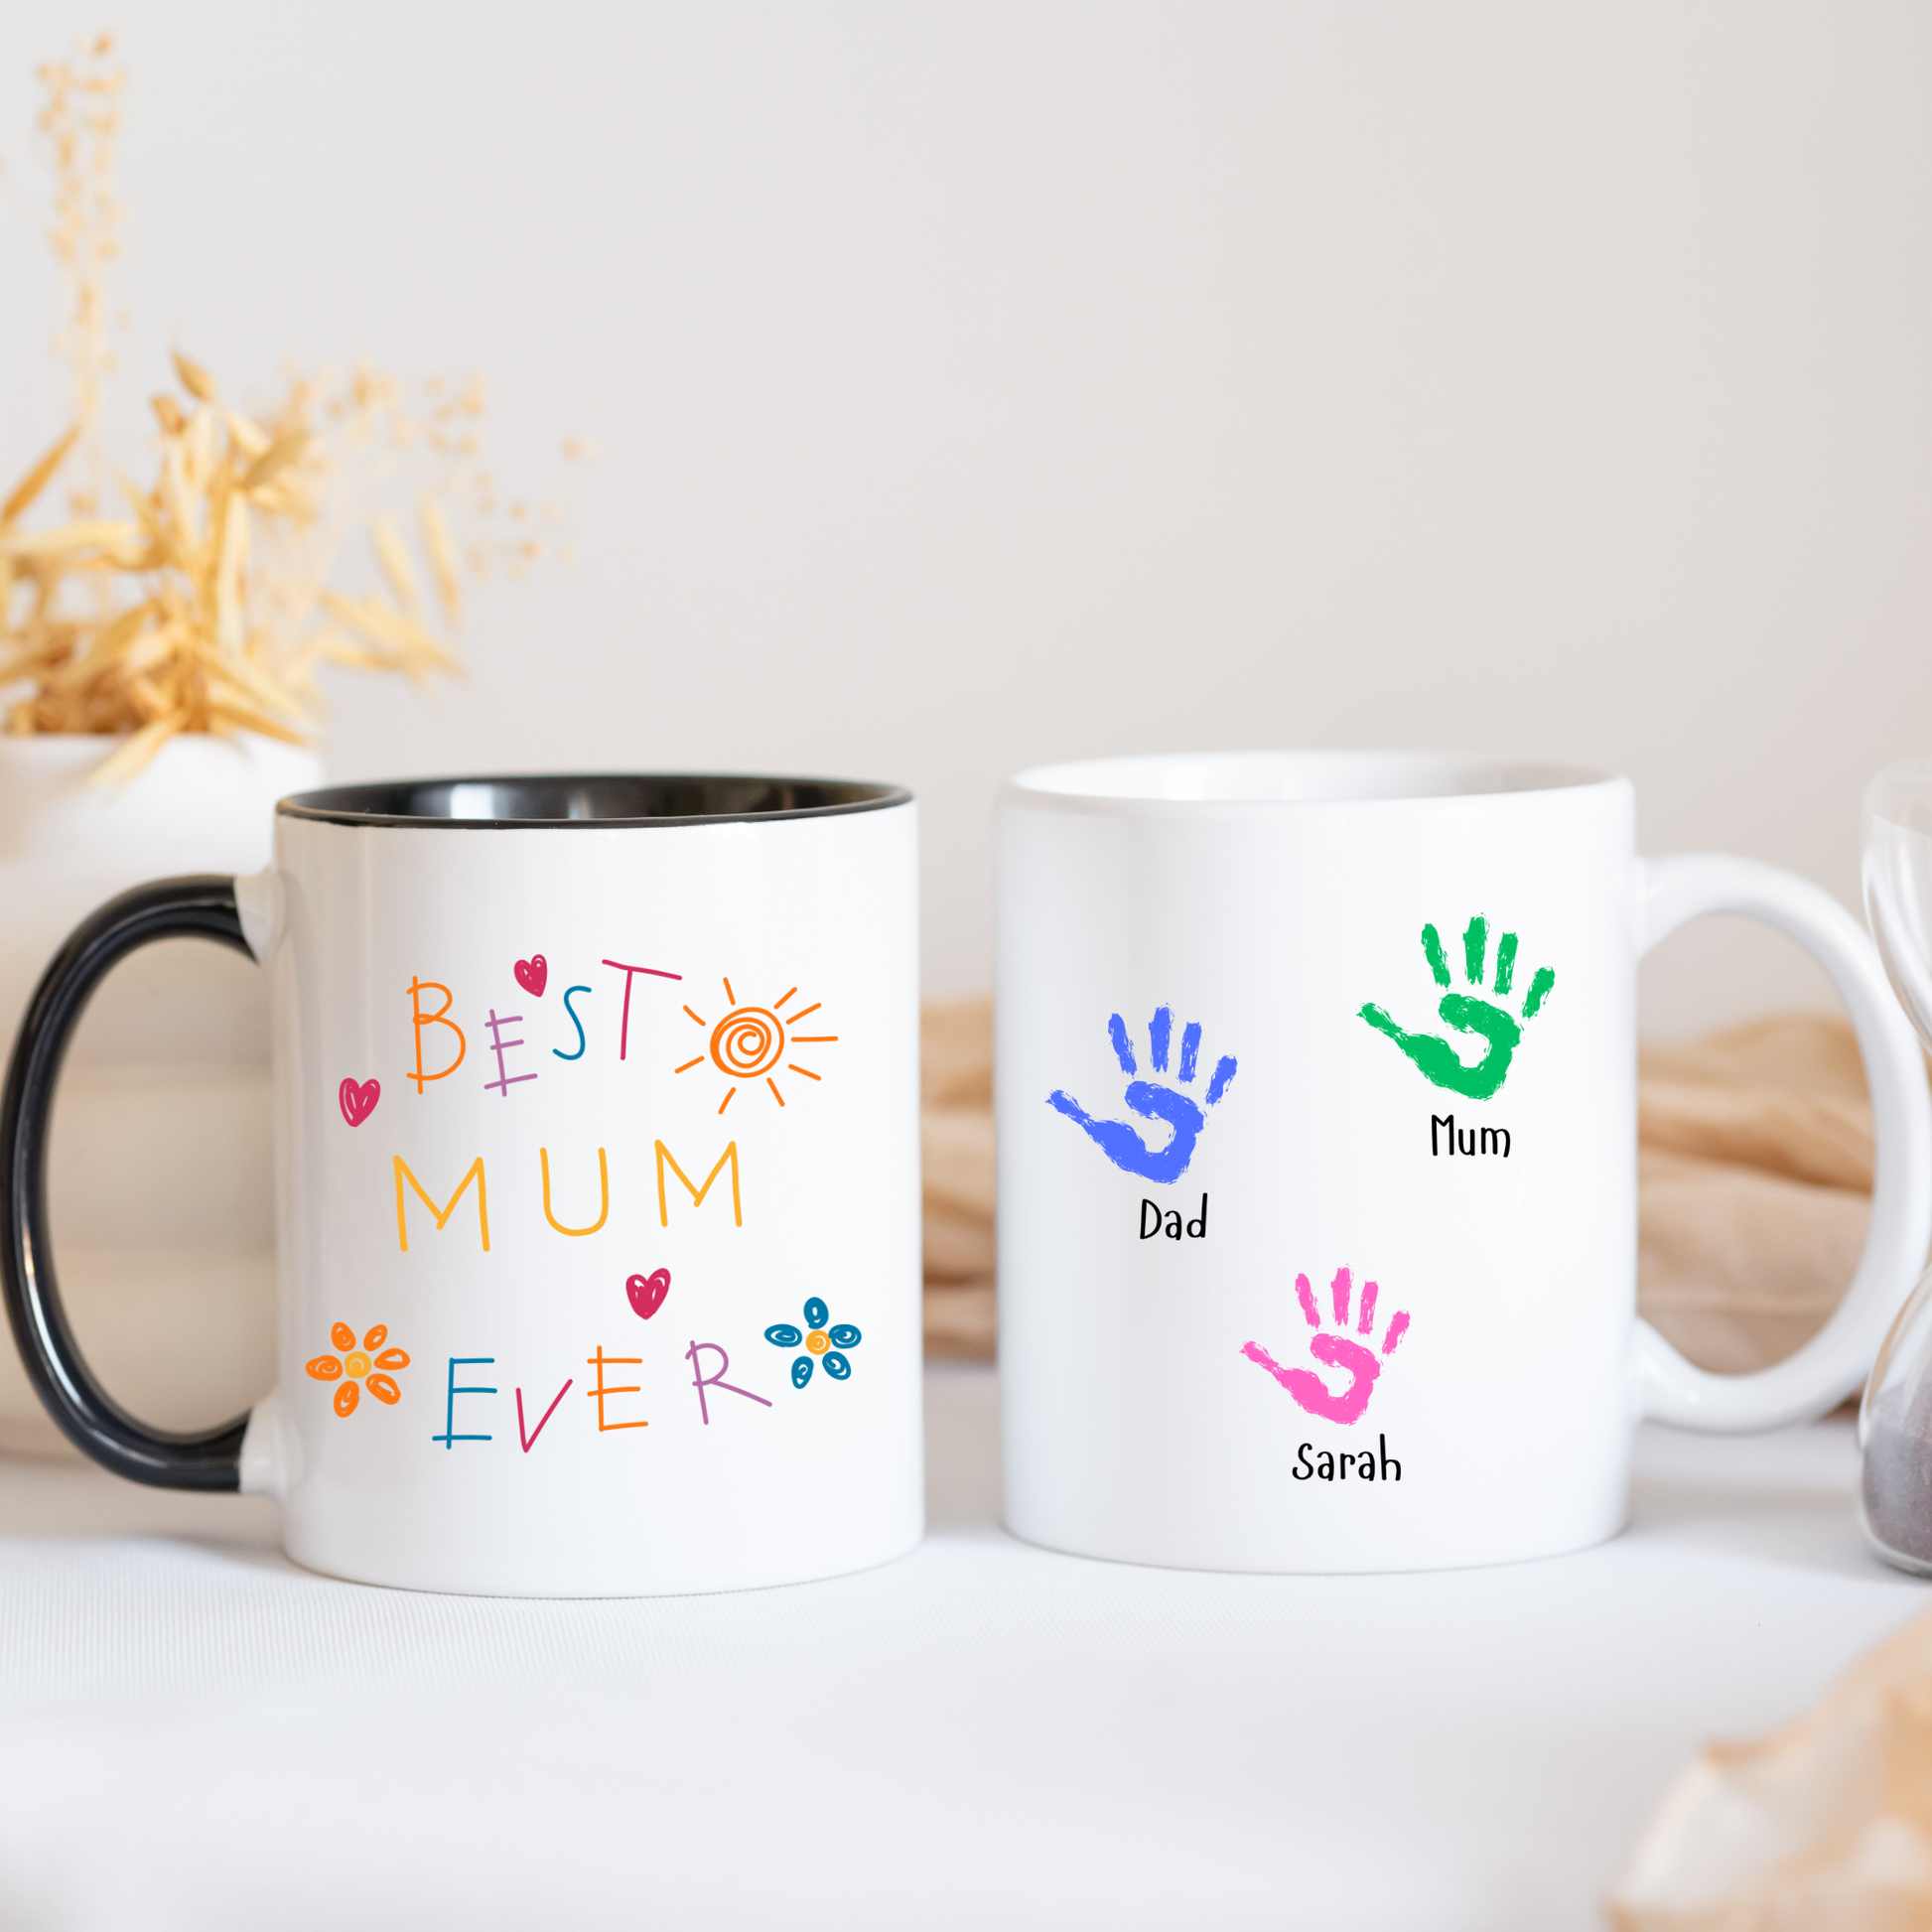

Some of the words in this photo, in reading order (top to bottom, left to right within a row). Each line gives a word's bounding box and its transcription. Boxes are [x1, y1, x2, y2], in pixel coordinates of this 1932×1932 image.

[405, 958, 683, 1097] BEST
[1431, 1114, 1511, 1159] Mum
[392, 1139, 744, 1253] MUM
[1139, 1192, 1208, 1241] Dad
[431, 1340, 773, 1453] EVER
[1292, 1433, 1402, 1481] Sarah
